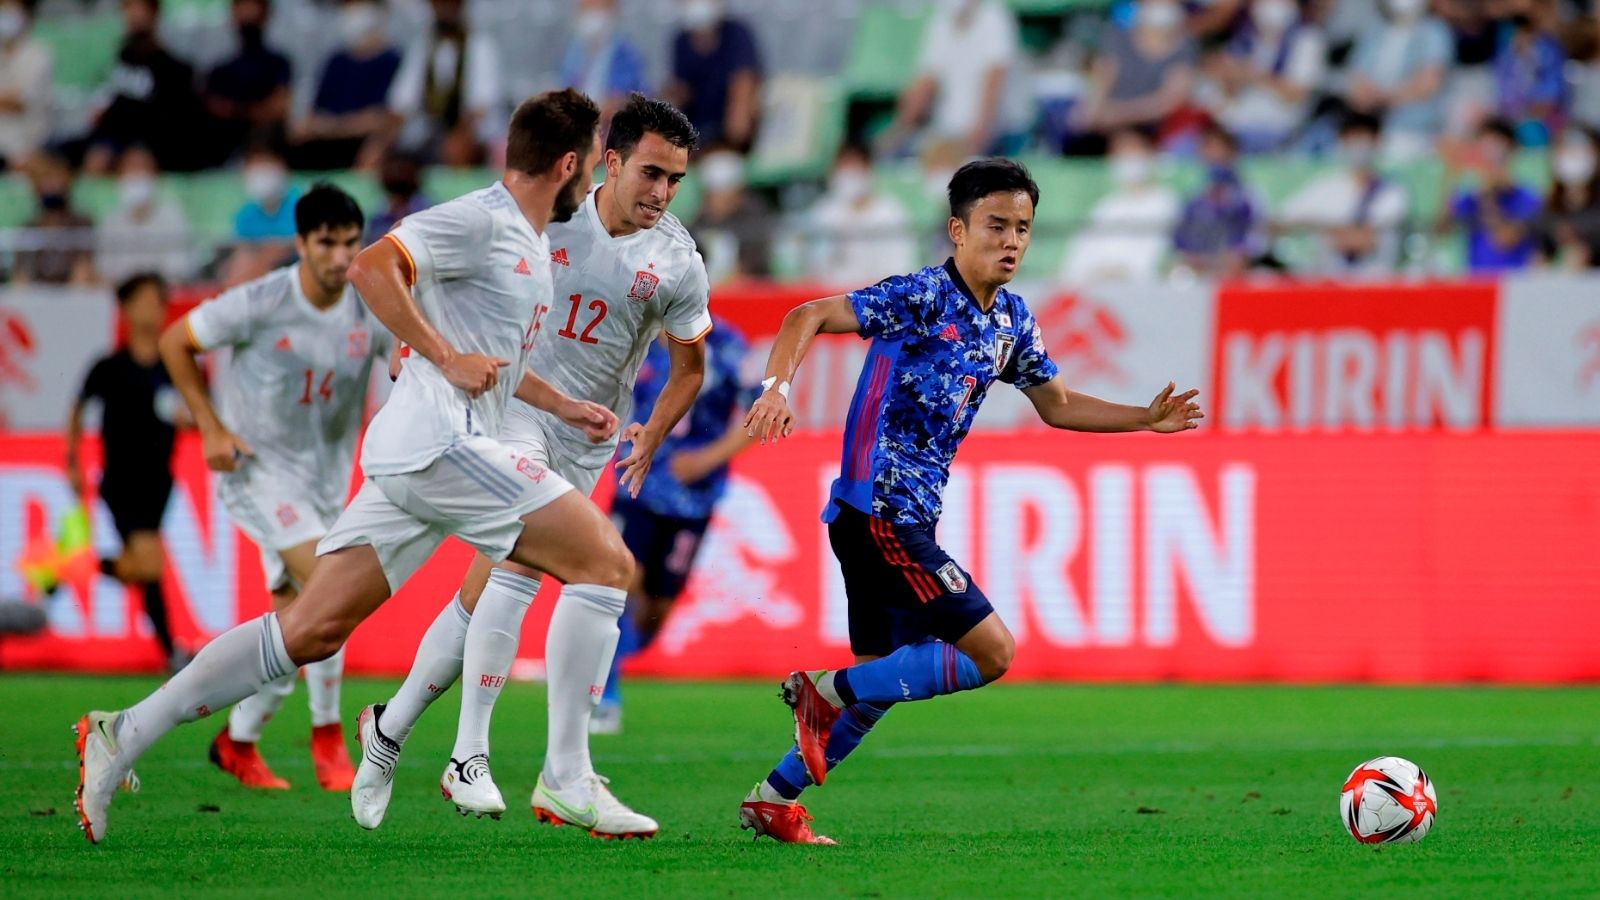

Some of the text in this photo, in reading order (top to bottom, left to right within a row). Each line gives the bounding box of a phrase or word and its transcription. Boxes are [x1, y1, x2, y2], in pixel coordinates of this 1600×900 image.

[557, 293, 608, 344] 12
[297, 367, 335, 406] 14
[952, 375, 977, 423] 7
[1224, 327, 1485, 432] KIRIN
[820, 463, 1256, 646] RIN
